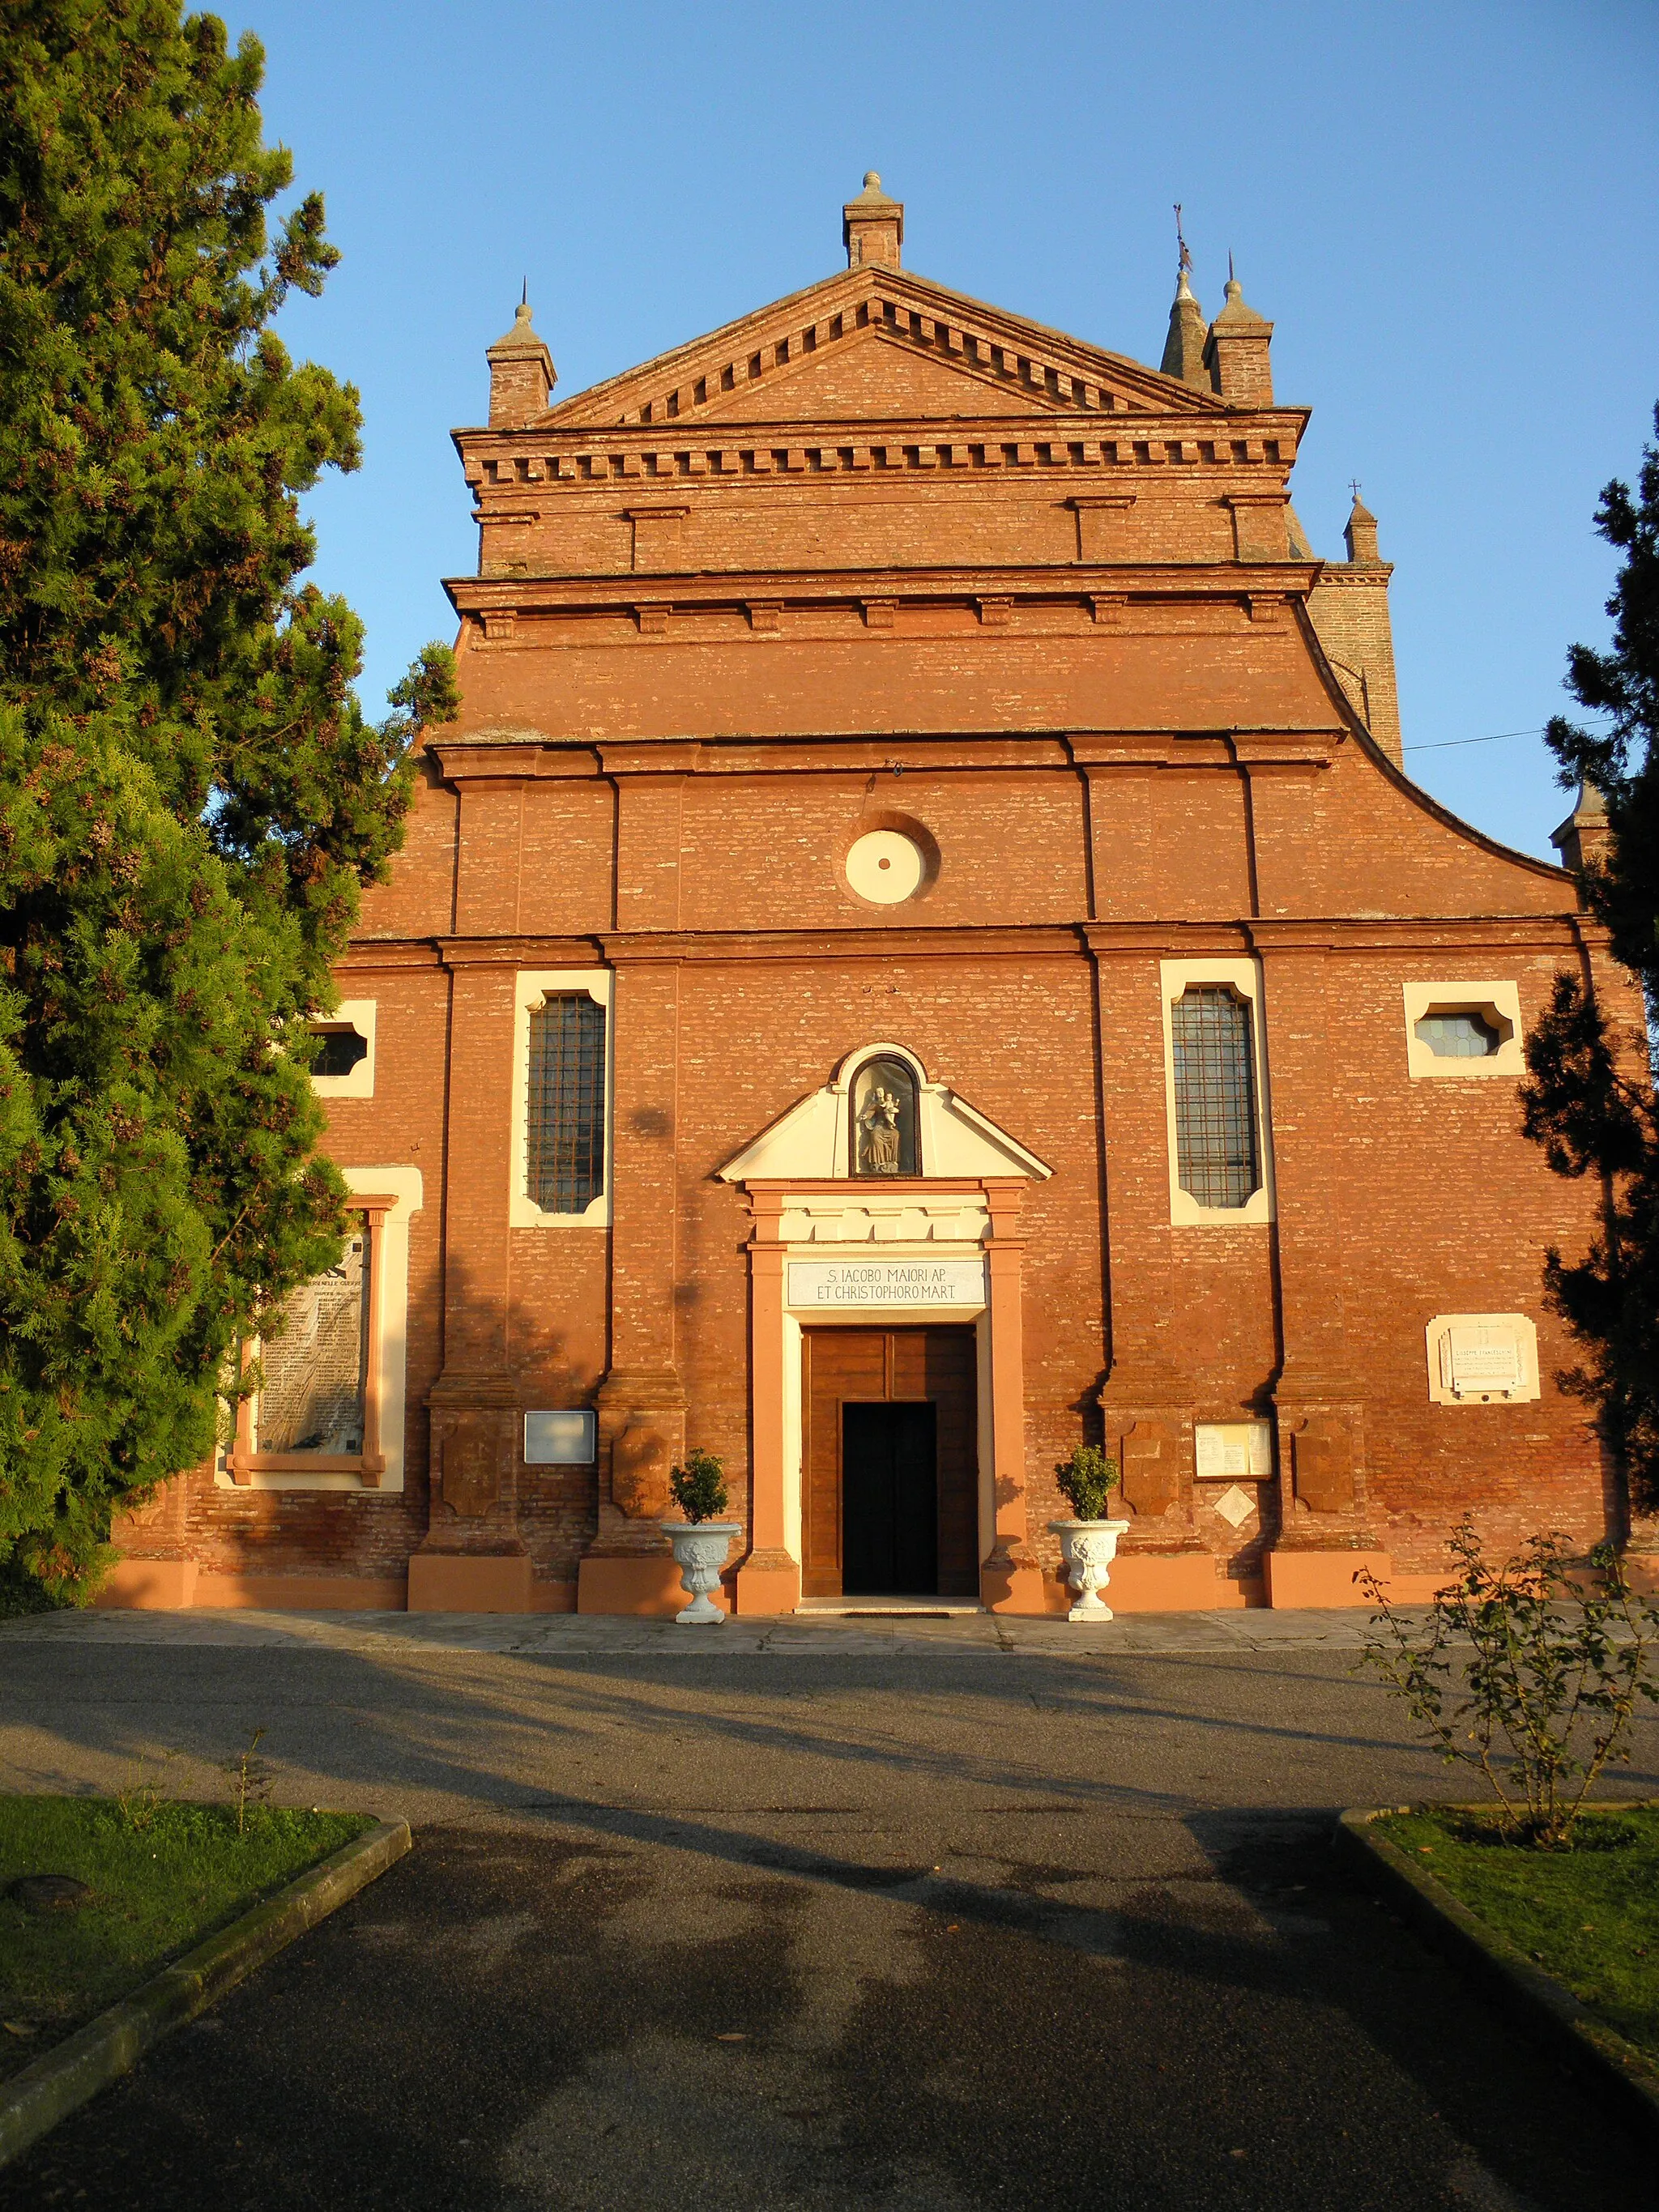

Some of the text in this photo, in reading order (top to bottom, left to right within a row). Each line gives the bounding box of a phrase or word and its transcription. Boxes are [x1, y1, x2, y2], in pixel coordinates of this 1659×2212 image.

[827, 1268, 946, 1282] S. IACOBO MAIORI AP.
[817, 1285, 956, 1299] ET CHRISTOPHORO MART.
